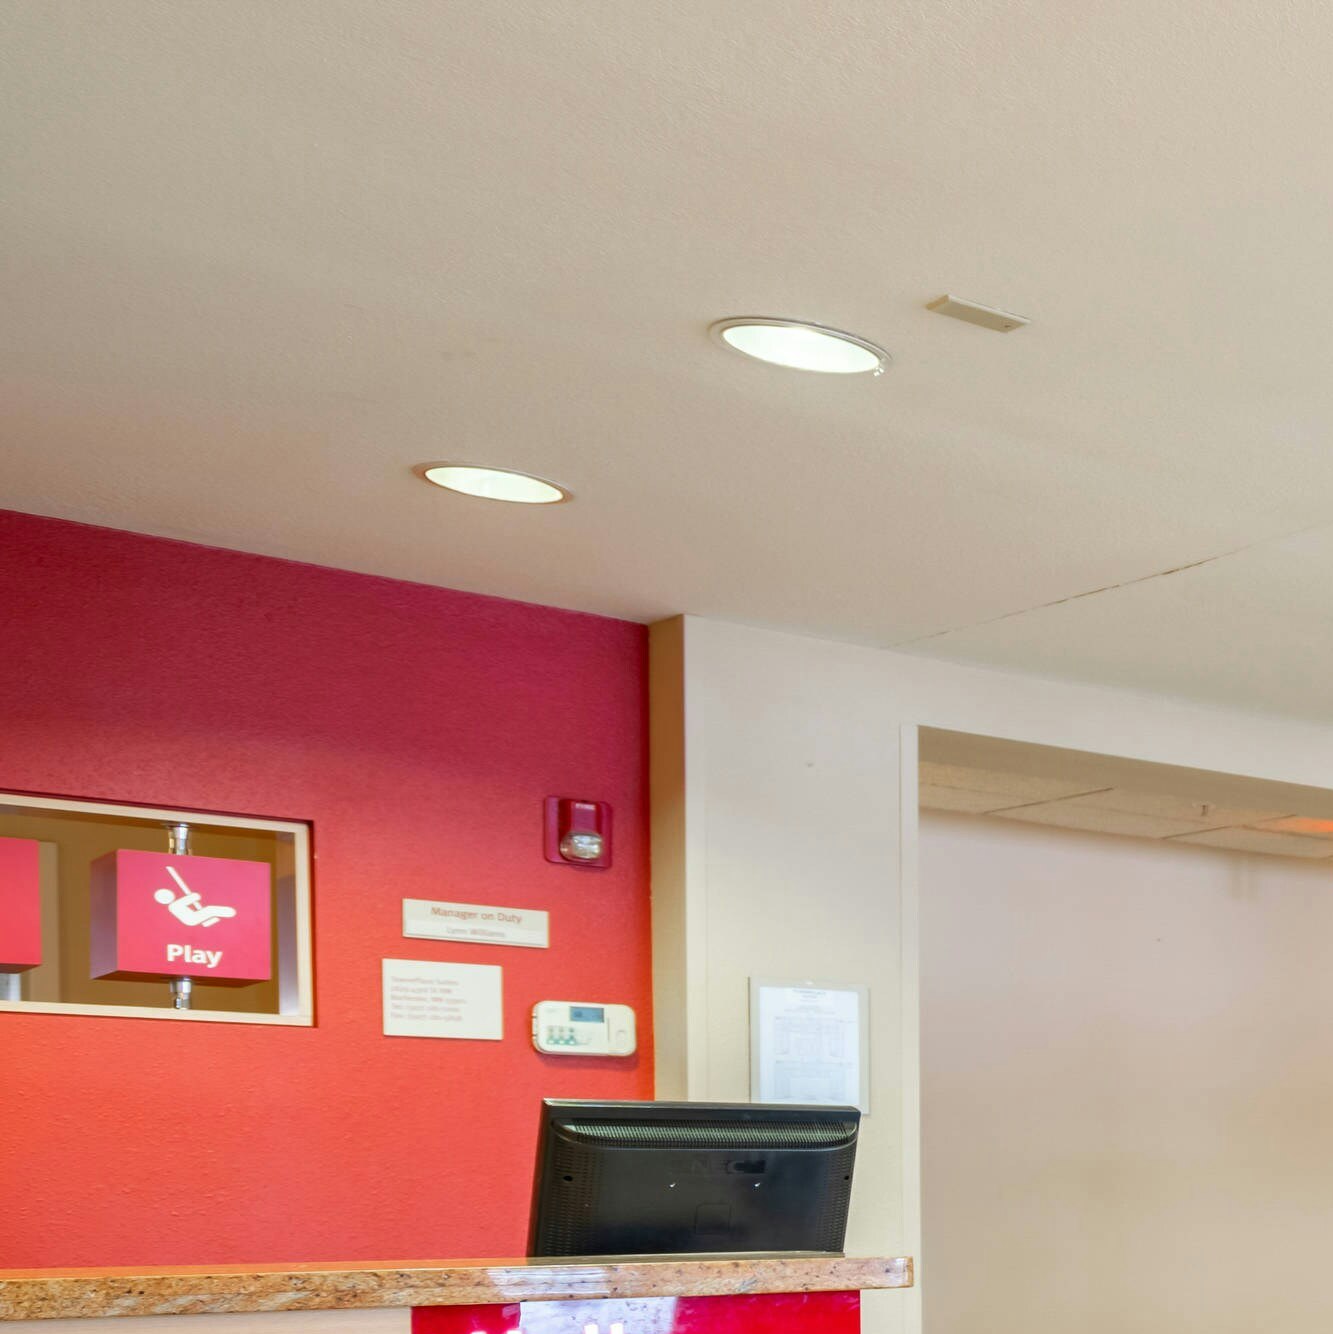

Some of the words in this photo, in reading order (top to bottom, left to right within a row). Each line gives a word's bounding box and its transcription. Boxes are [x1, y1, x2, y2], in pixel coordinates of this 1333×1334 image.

[431, 907, 478, 920] Manager
[481, 912, 494, 920] on
[497, 912, 523, 924] Duty
[167, 943, 223, 968] Play
